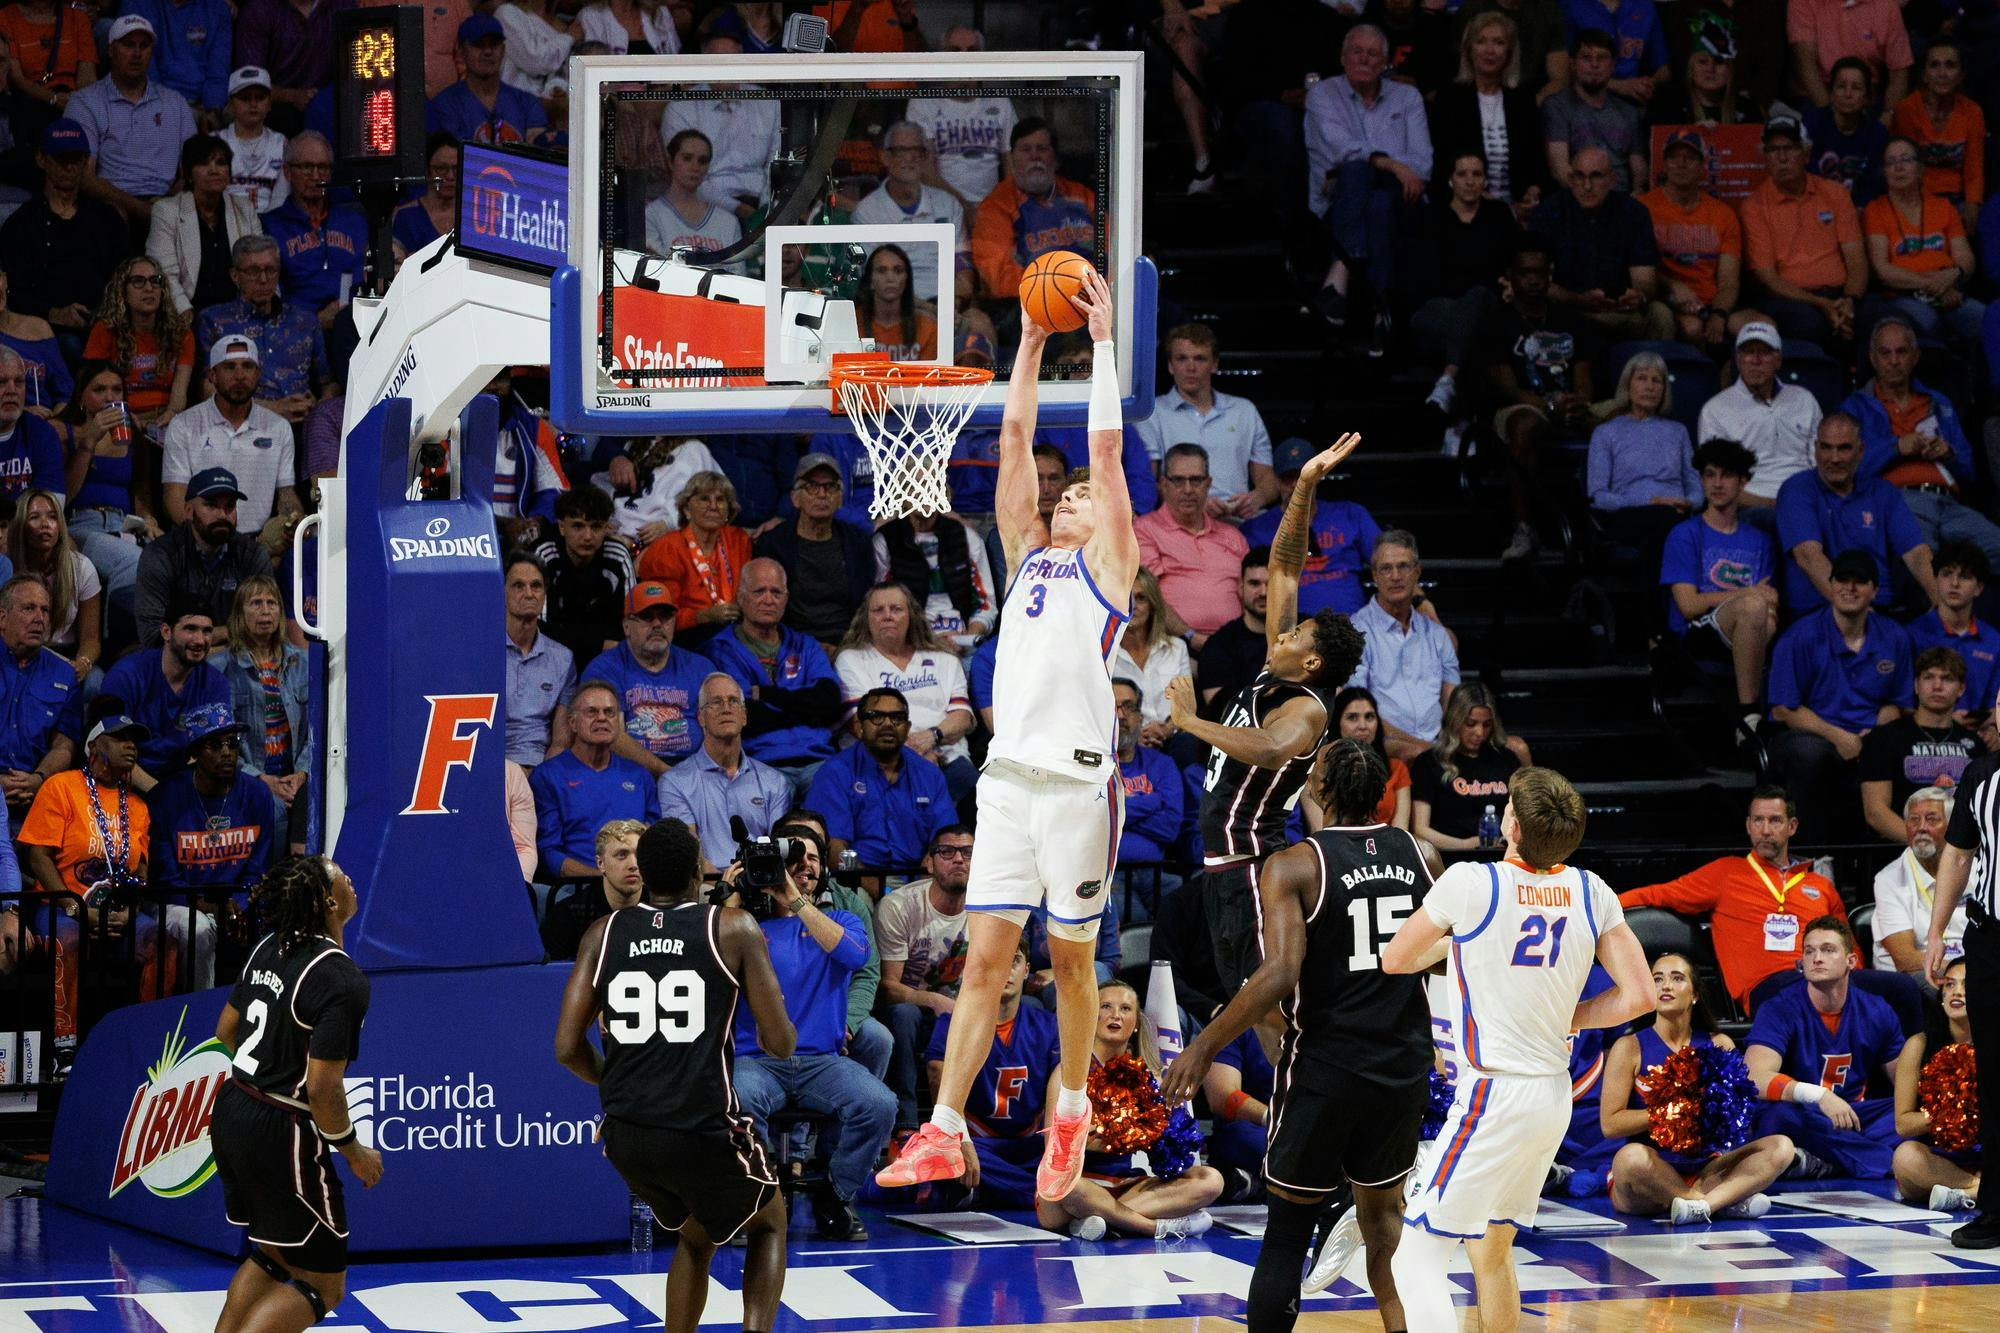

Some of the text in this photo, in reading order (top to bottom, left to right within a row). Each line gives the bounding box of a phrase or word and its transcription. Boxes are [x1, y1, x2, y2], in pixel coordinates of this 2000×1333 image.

[386, 344, 416, 399] LDING
[596, 395, 650, 409] SPALDING
[390, 534, 497, 562] SPALDING
[1026, 584, 1047, 619] 3
[880, 669, 936, 690] Florida
[399, 693, 498, 815] F
[1203, 745, 1228, 793] 3
[1912, 744, 1967, 758] NATIONAL
[180, 828, 257, 861] FLORIDA
[1341, 864, 1416, 890] BALLARD
[1517, 884, 1571, 907] CONDON
[628, 937, 685, 958] ACHOR
[1511, 914, 1568, 968] 21
[608, 970, 706, 1044] 99
[23, 1037, 33, 1069] BEYOND
[233, 998, 268, 1077] 2
[378, 1072, 496, 1111] Florida
[986, 1065, 1028, 1119] F
[109, 1071, 226, 1198] LIBMA
[378, 1113, 486, 1151] Credit
